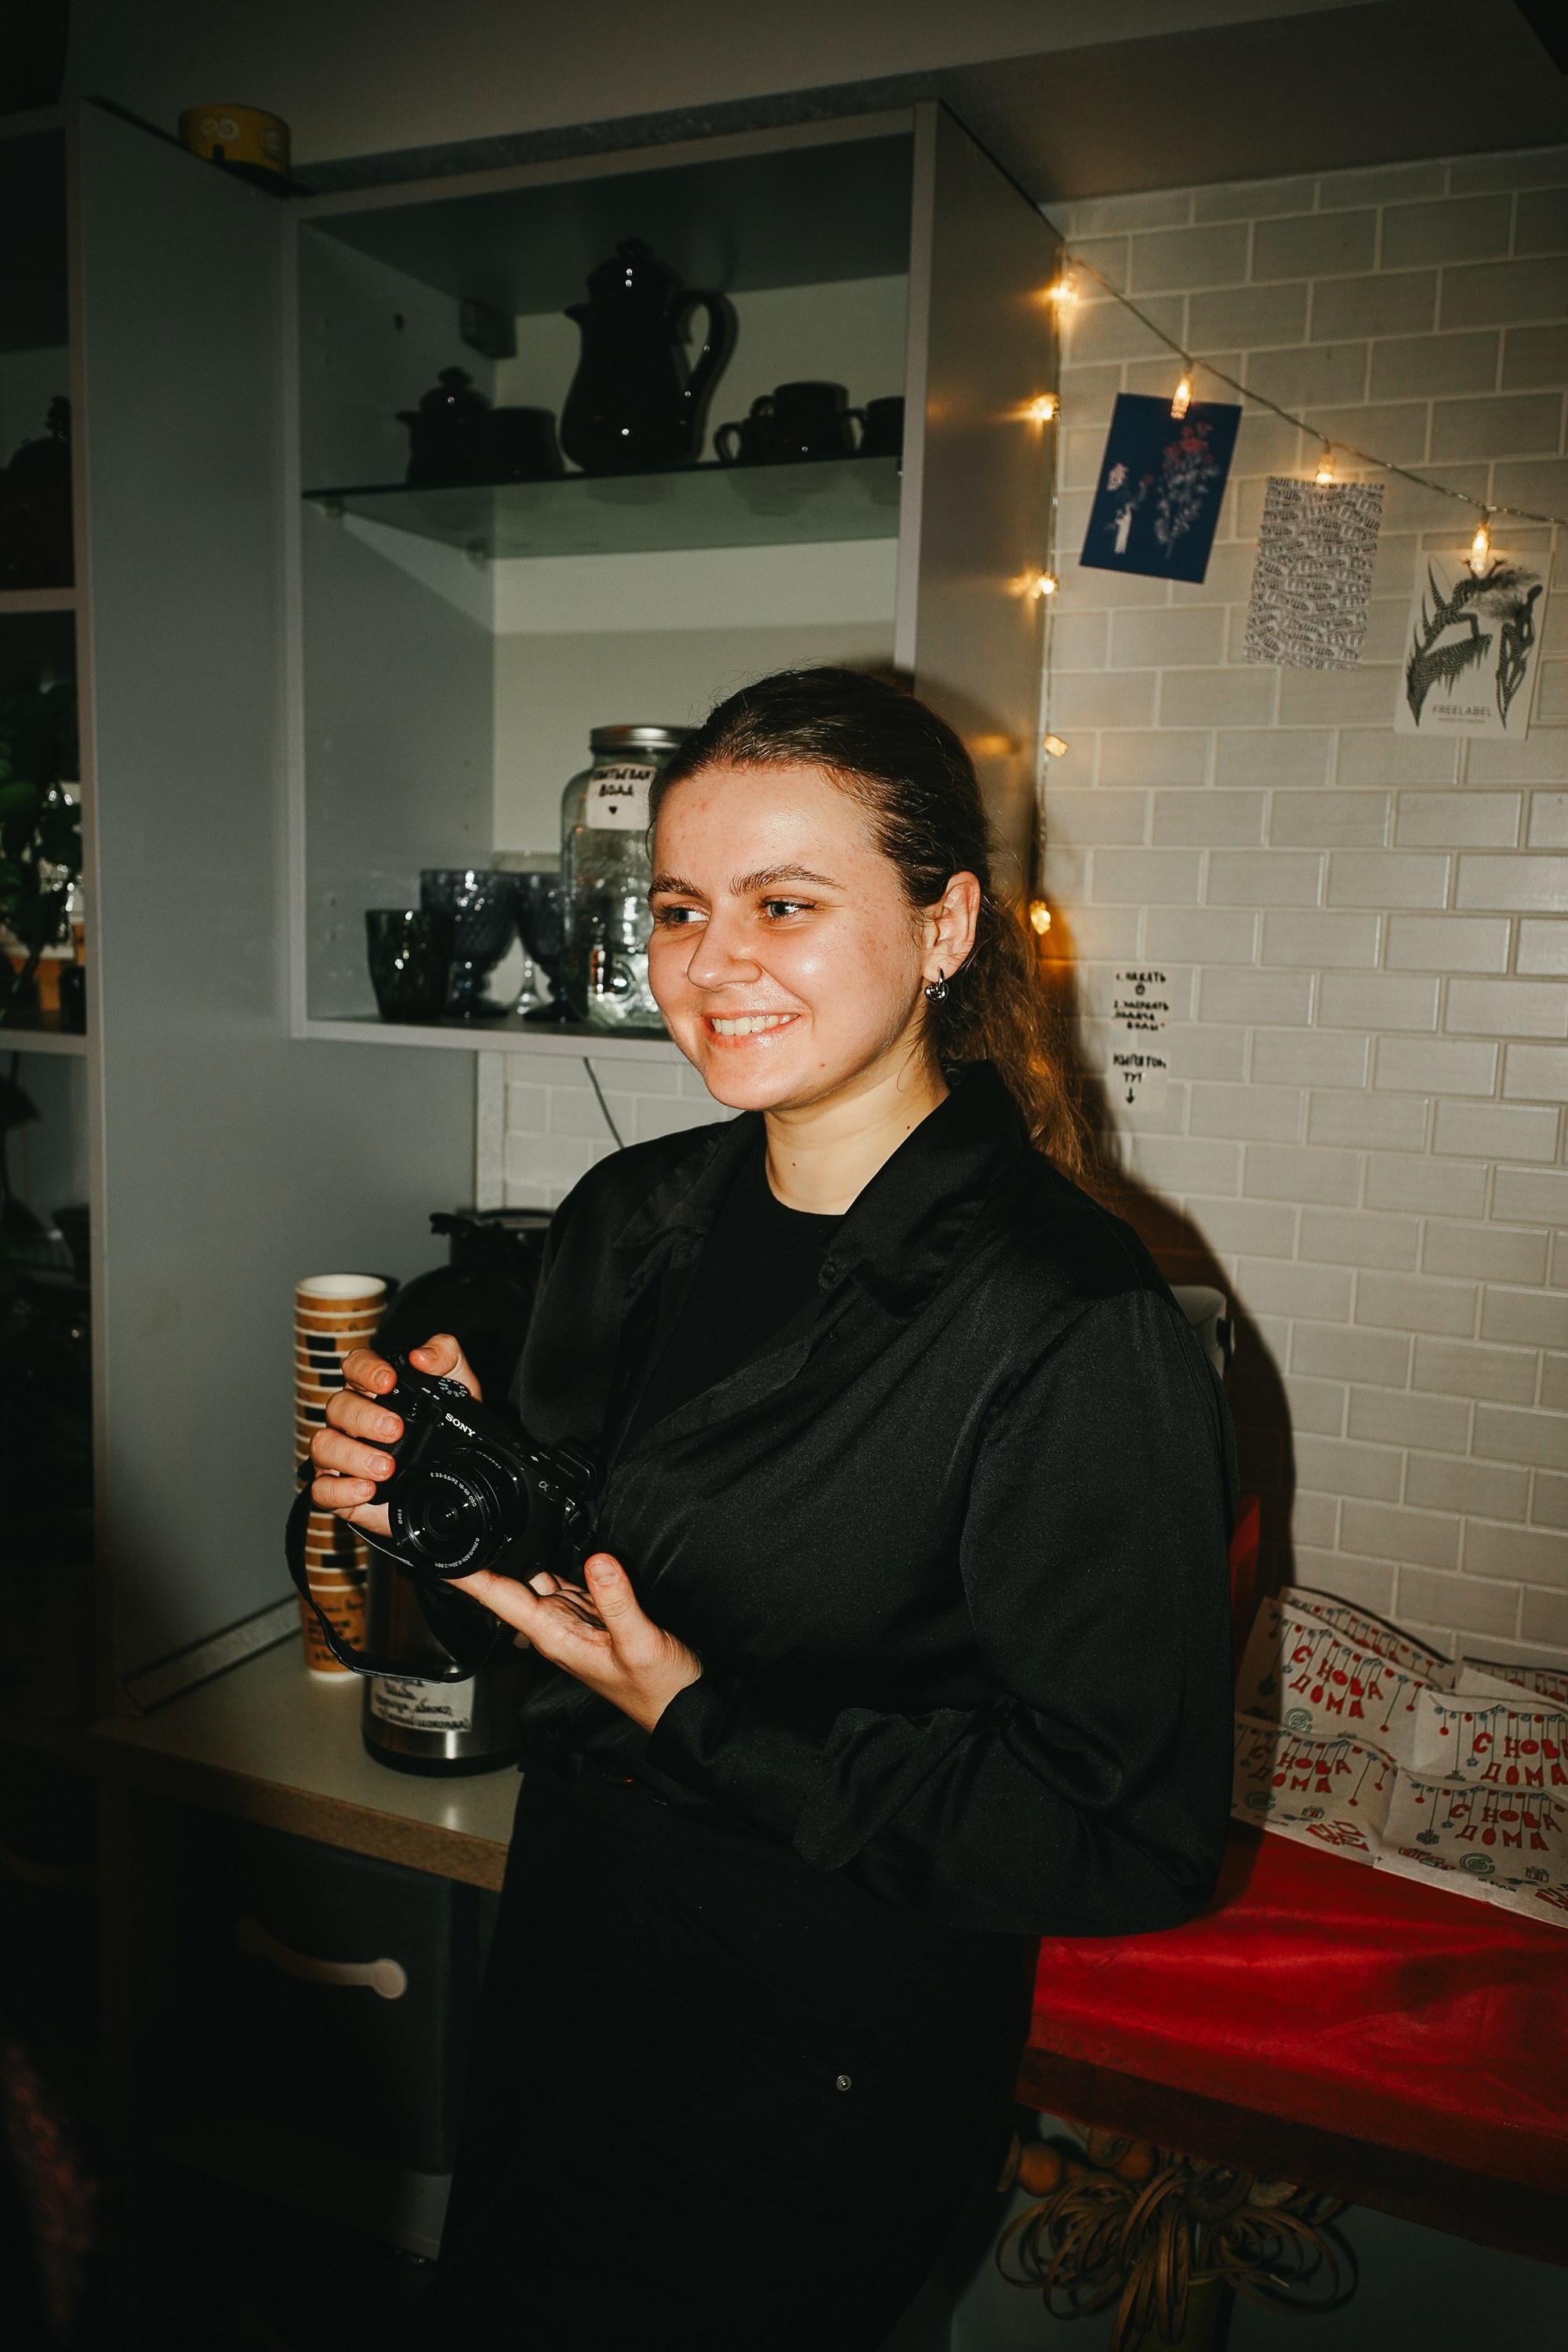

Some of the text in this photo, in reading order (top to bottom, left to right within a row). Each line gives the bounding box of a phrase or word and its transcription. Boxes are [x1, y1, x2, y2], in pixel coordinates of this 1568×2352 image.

[1432, 704, 1491, 717] FREELABEL
[445, 1413, 477, 1437] SONY
[1290, 1673, 1364, 1719] ДОМА
[1480, 1762, 1568, 1787] ДОМА
[1455, 1824, 1549, 1851] ДОМА
